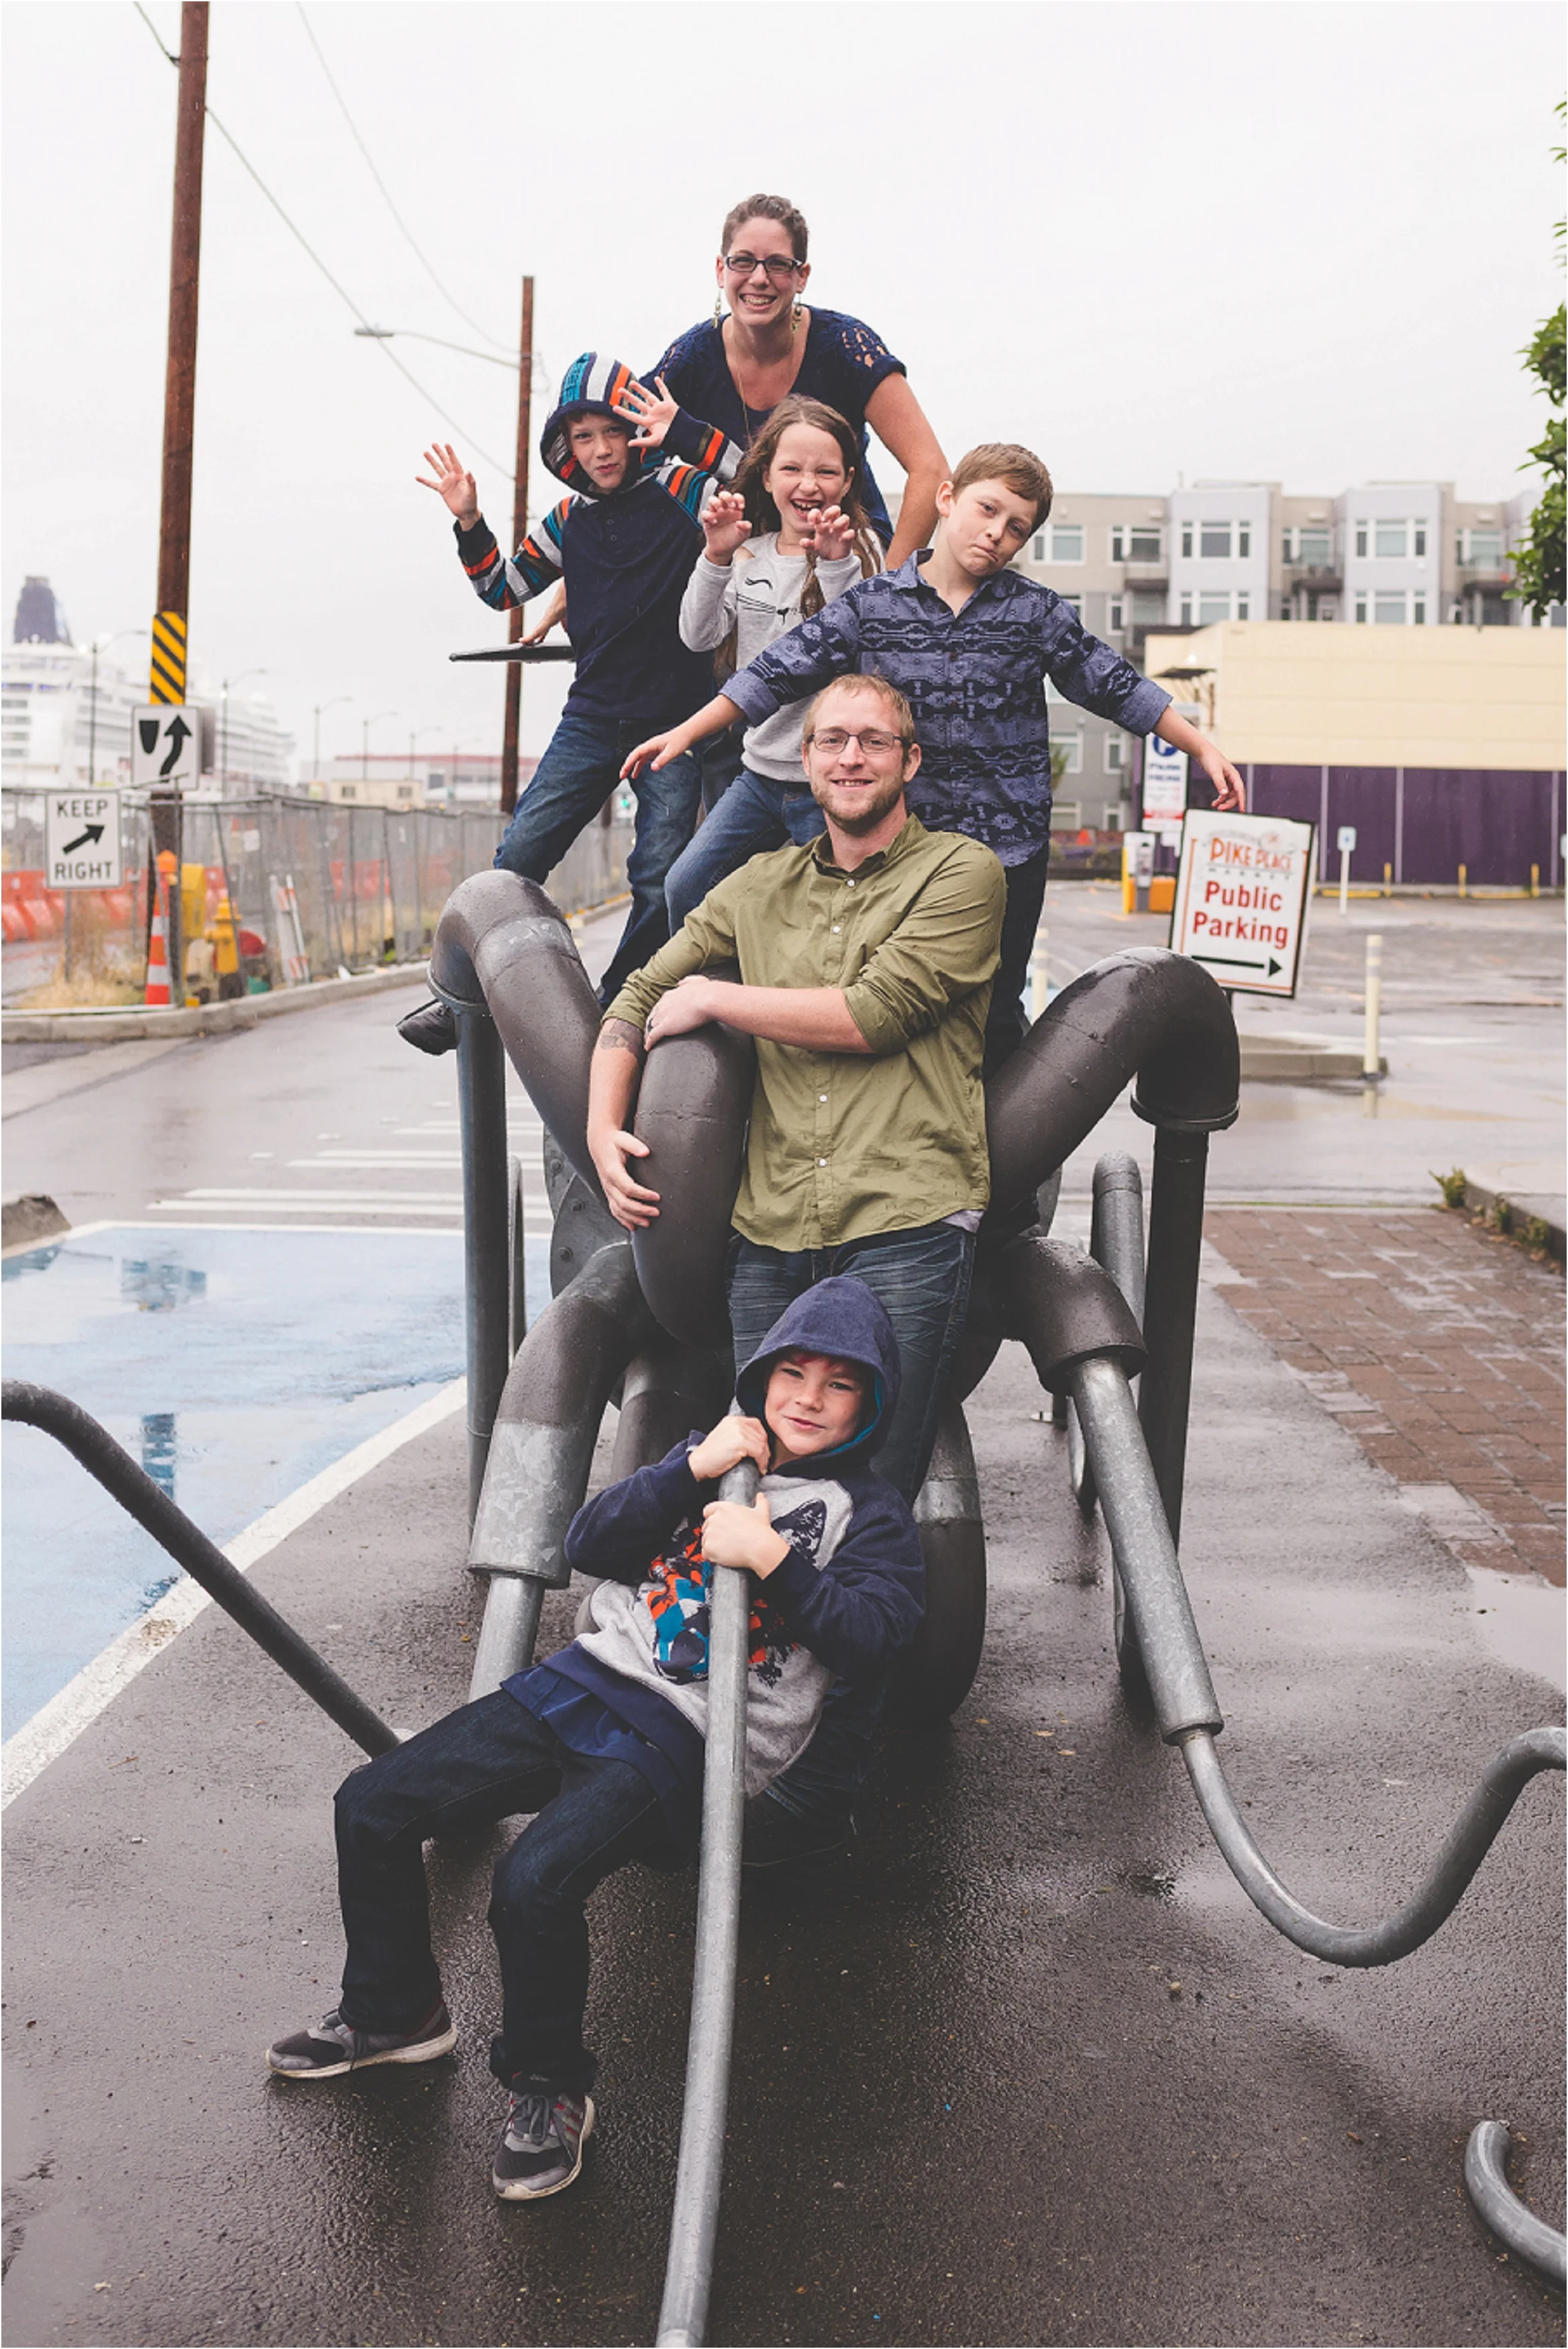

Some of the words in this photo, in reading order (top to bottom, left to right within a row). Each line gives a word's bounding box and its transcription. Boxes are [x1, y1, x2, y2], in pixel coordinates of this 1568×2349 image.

[56, 799, 109, 817] KEEP
[1210, 837, 1251, 866] PIKE
[54, 861, 112, 880] RIGHT
[1205, 880, 1283, 911] Public
[1193, 911, 1288, 950] Parking
